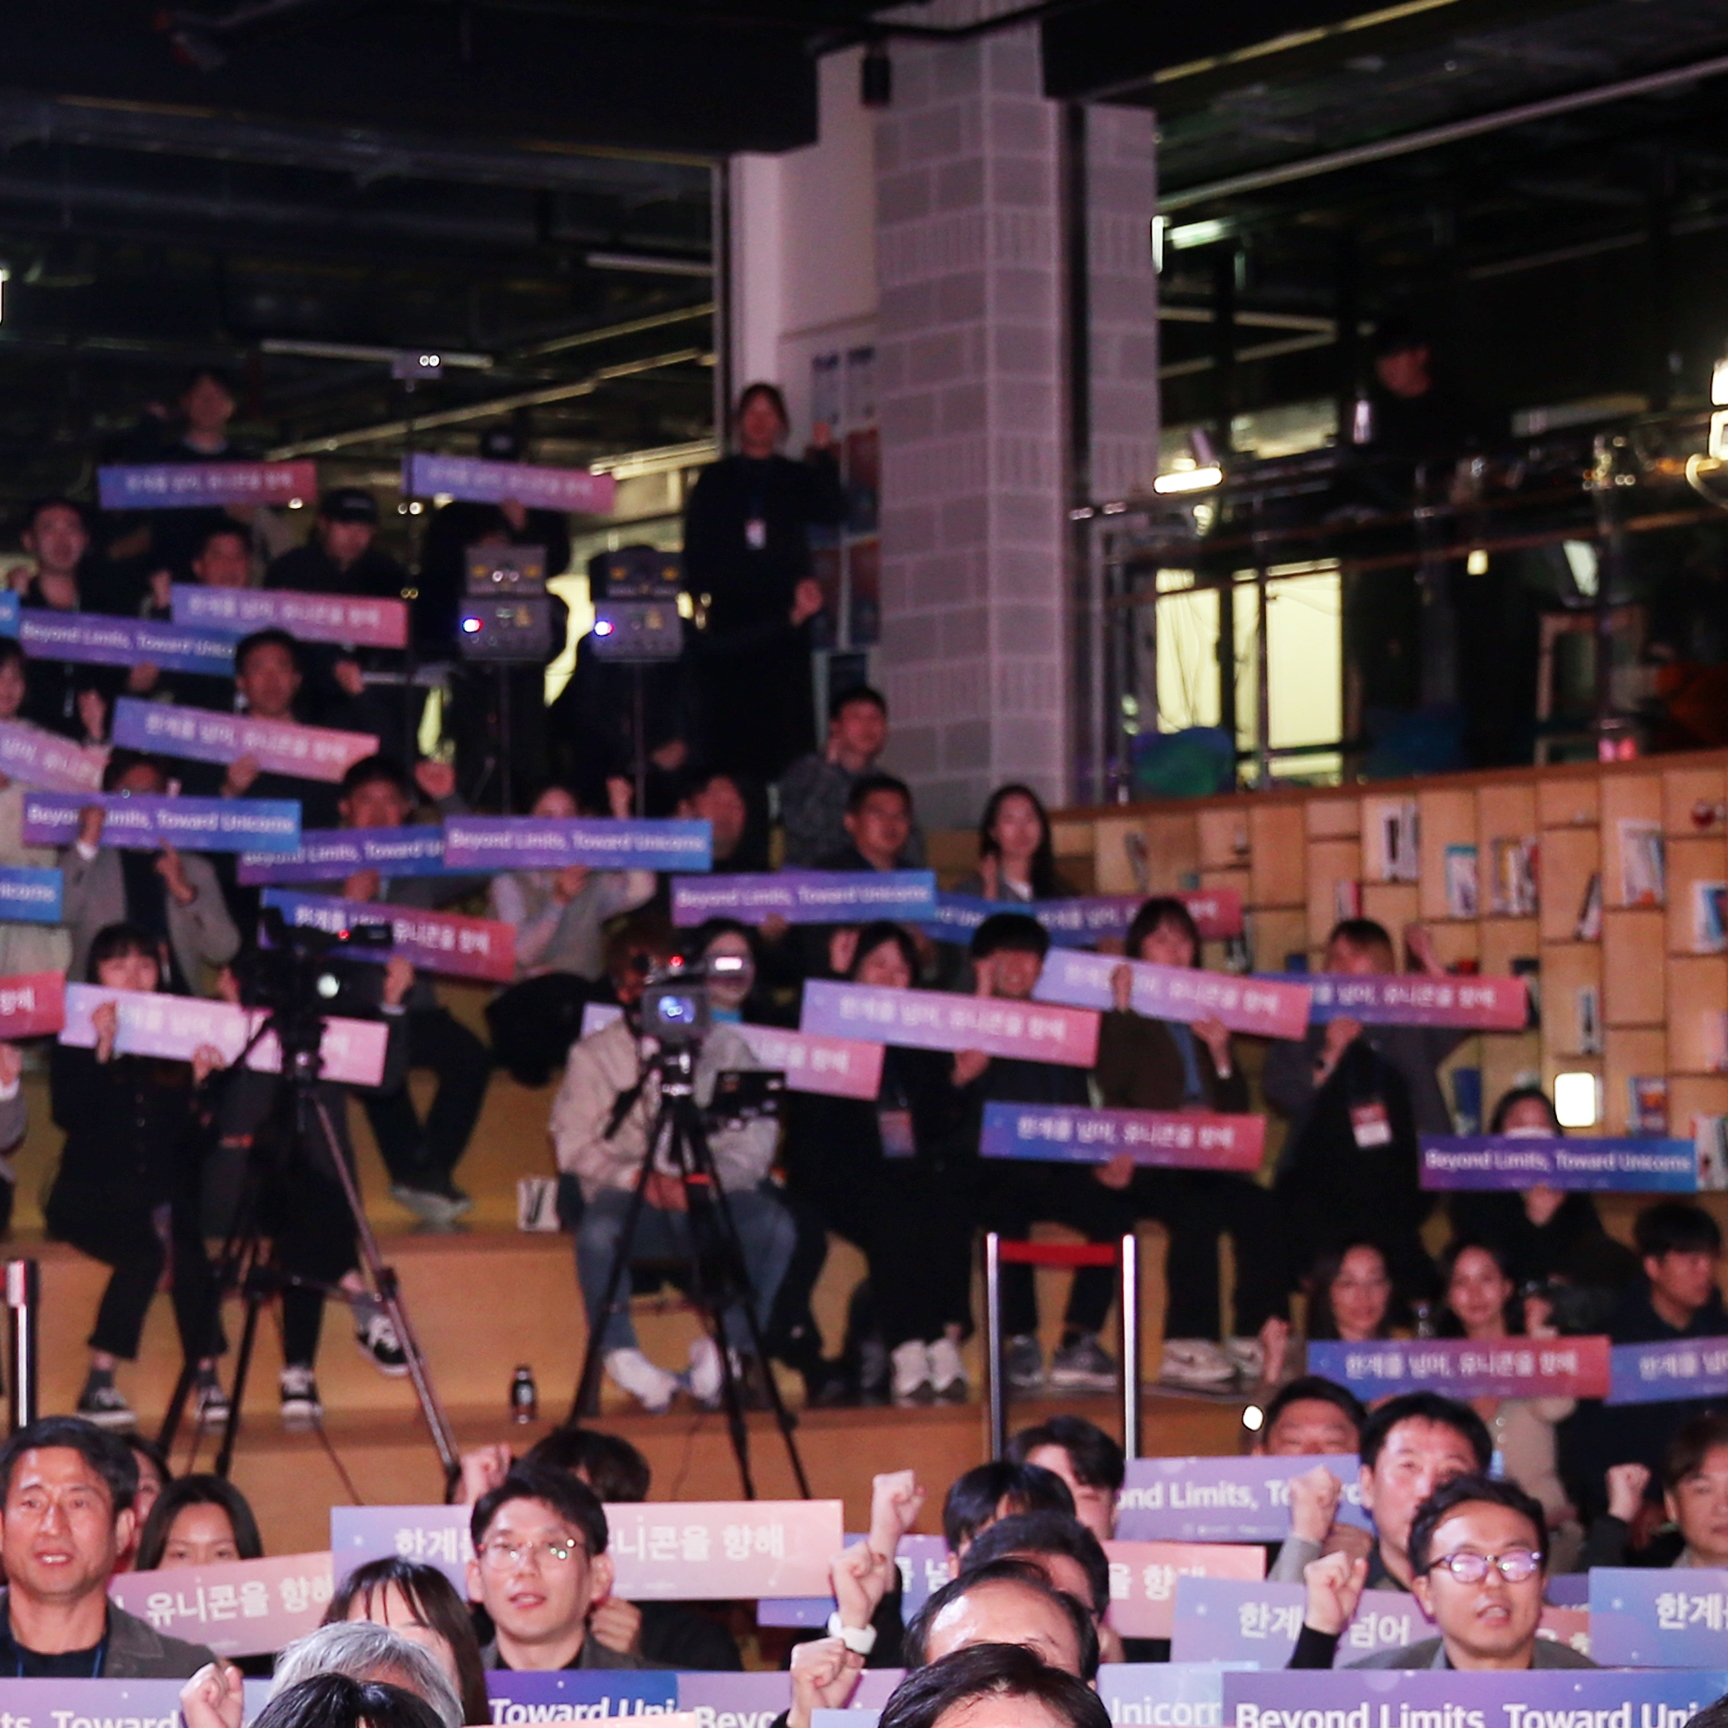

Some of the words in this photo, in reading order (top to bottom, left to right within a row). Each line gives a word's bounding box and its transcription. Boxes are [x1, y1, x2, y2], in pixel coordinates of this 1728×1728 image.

[1170, 1480, 1259, 1512] Limits,
[721, 1523, 784, 1560] 향해
[146, 1578, 271, 1628] 유니콘을
